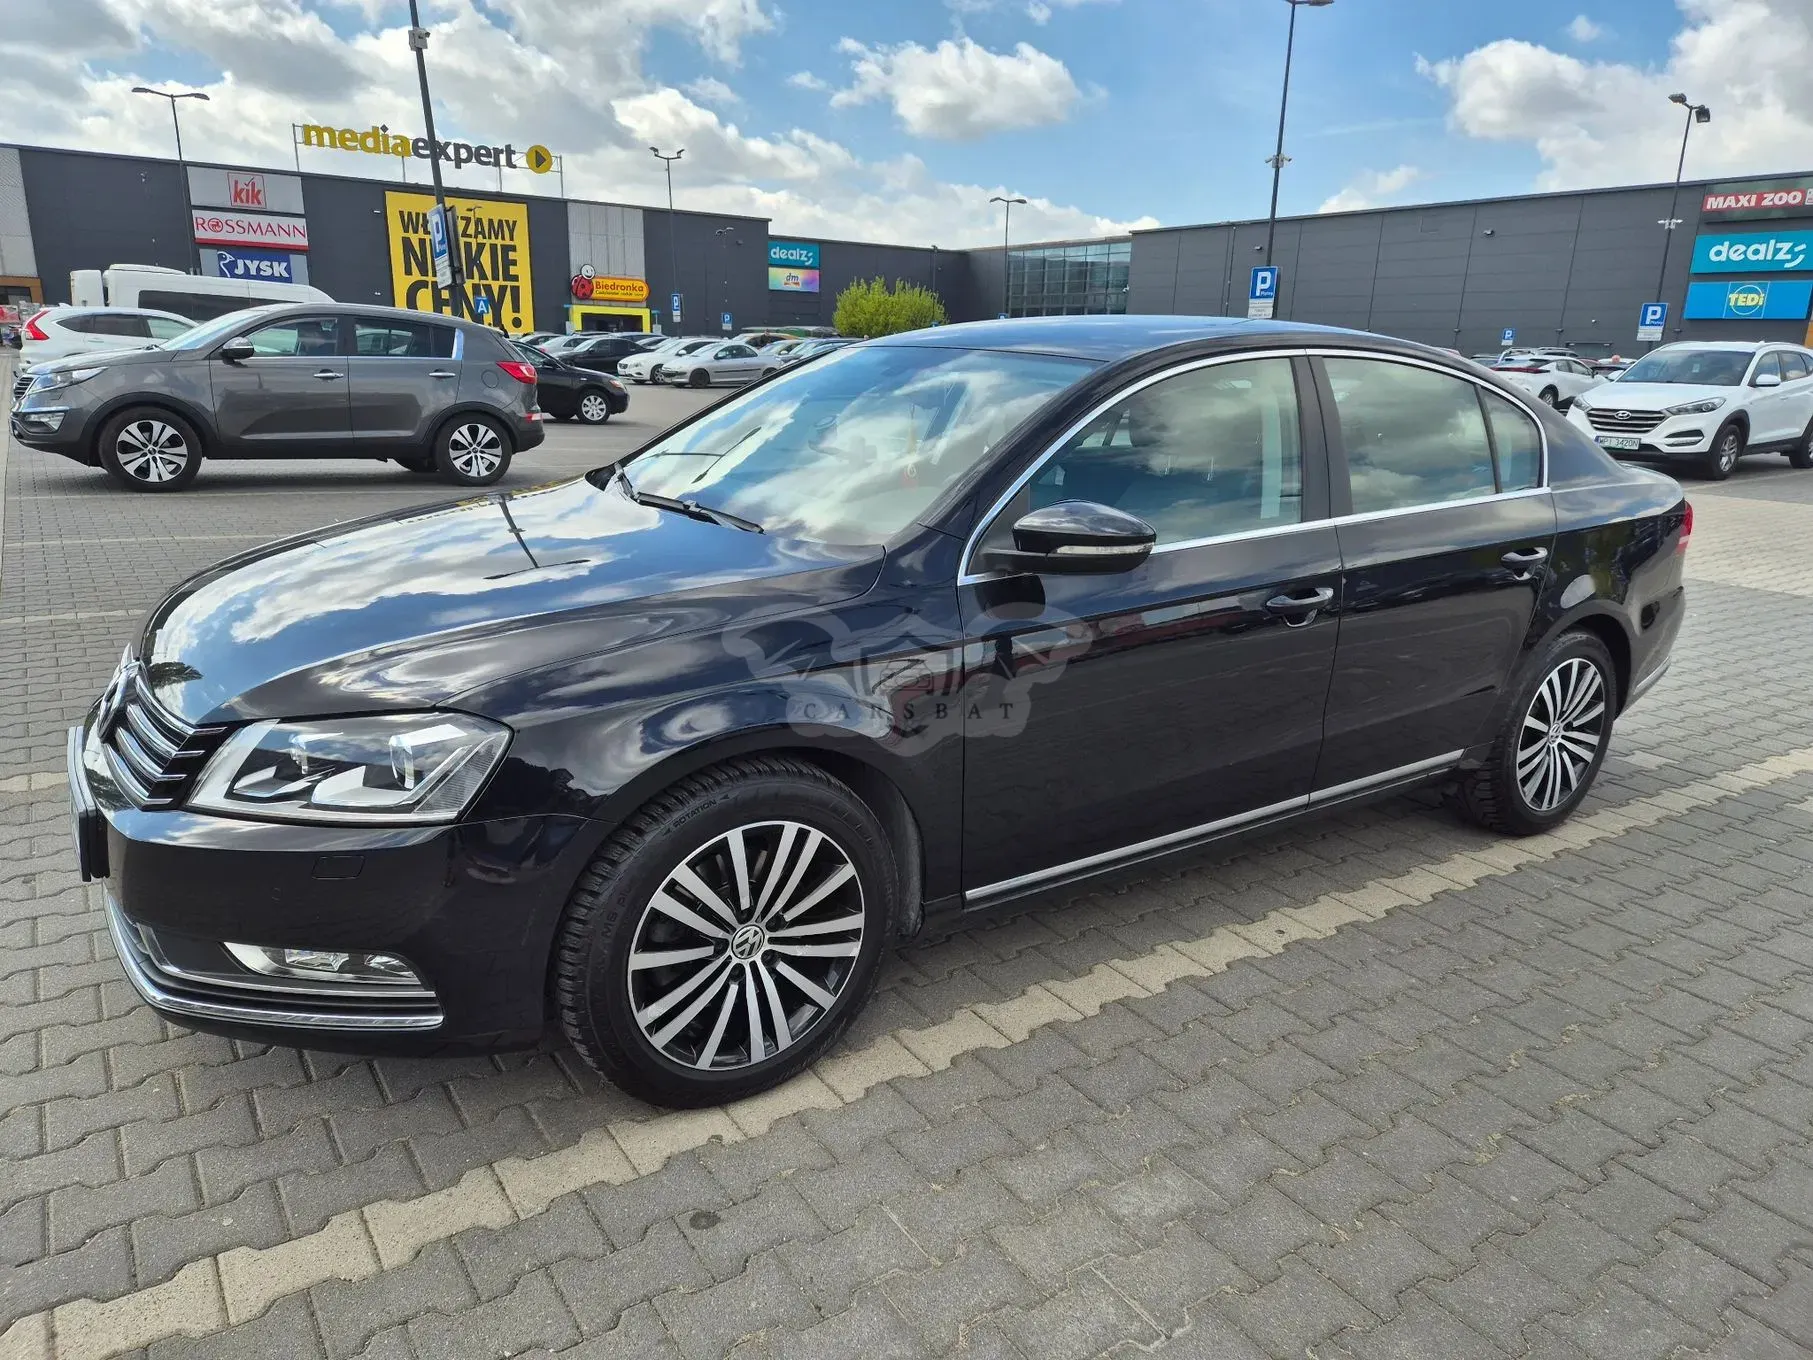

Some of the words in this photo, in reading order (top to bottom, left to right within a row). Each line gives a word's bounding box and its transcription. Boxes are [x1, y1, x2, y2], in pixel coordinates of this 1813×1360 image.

[1706, 194, 1757, 209] MAXI
[1761, 191, 1802, 206] ZOO
[195, 216, 306, 239] ROSSMANN
[399, 210, 518, 242] WŁZAMY
[431, 213, 444, 254] P
[401, 236, 520, 282] NIKIE
[771, 246, 808, 261] dealz
[1709, 239, 1794, 262] dealz
[234, 259, 290, 278] JYSK
[785, 273, 799, 281] dm
[595, 281, 644, 292] Biedronka
[1256, 271, 1272, 297] P
[477, 301, 488, 313] A
[1645, 306, 1662, 325] P
[673, 800, 717, 828] ROTATION
